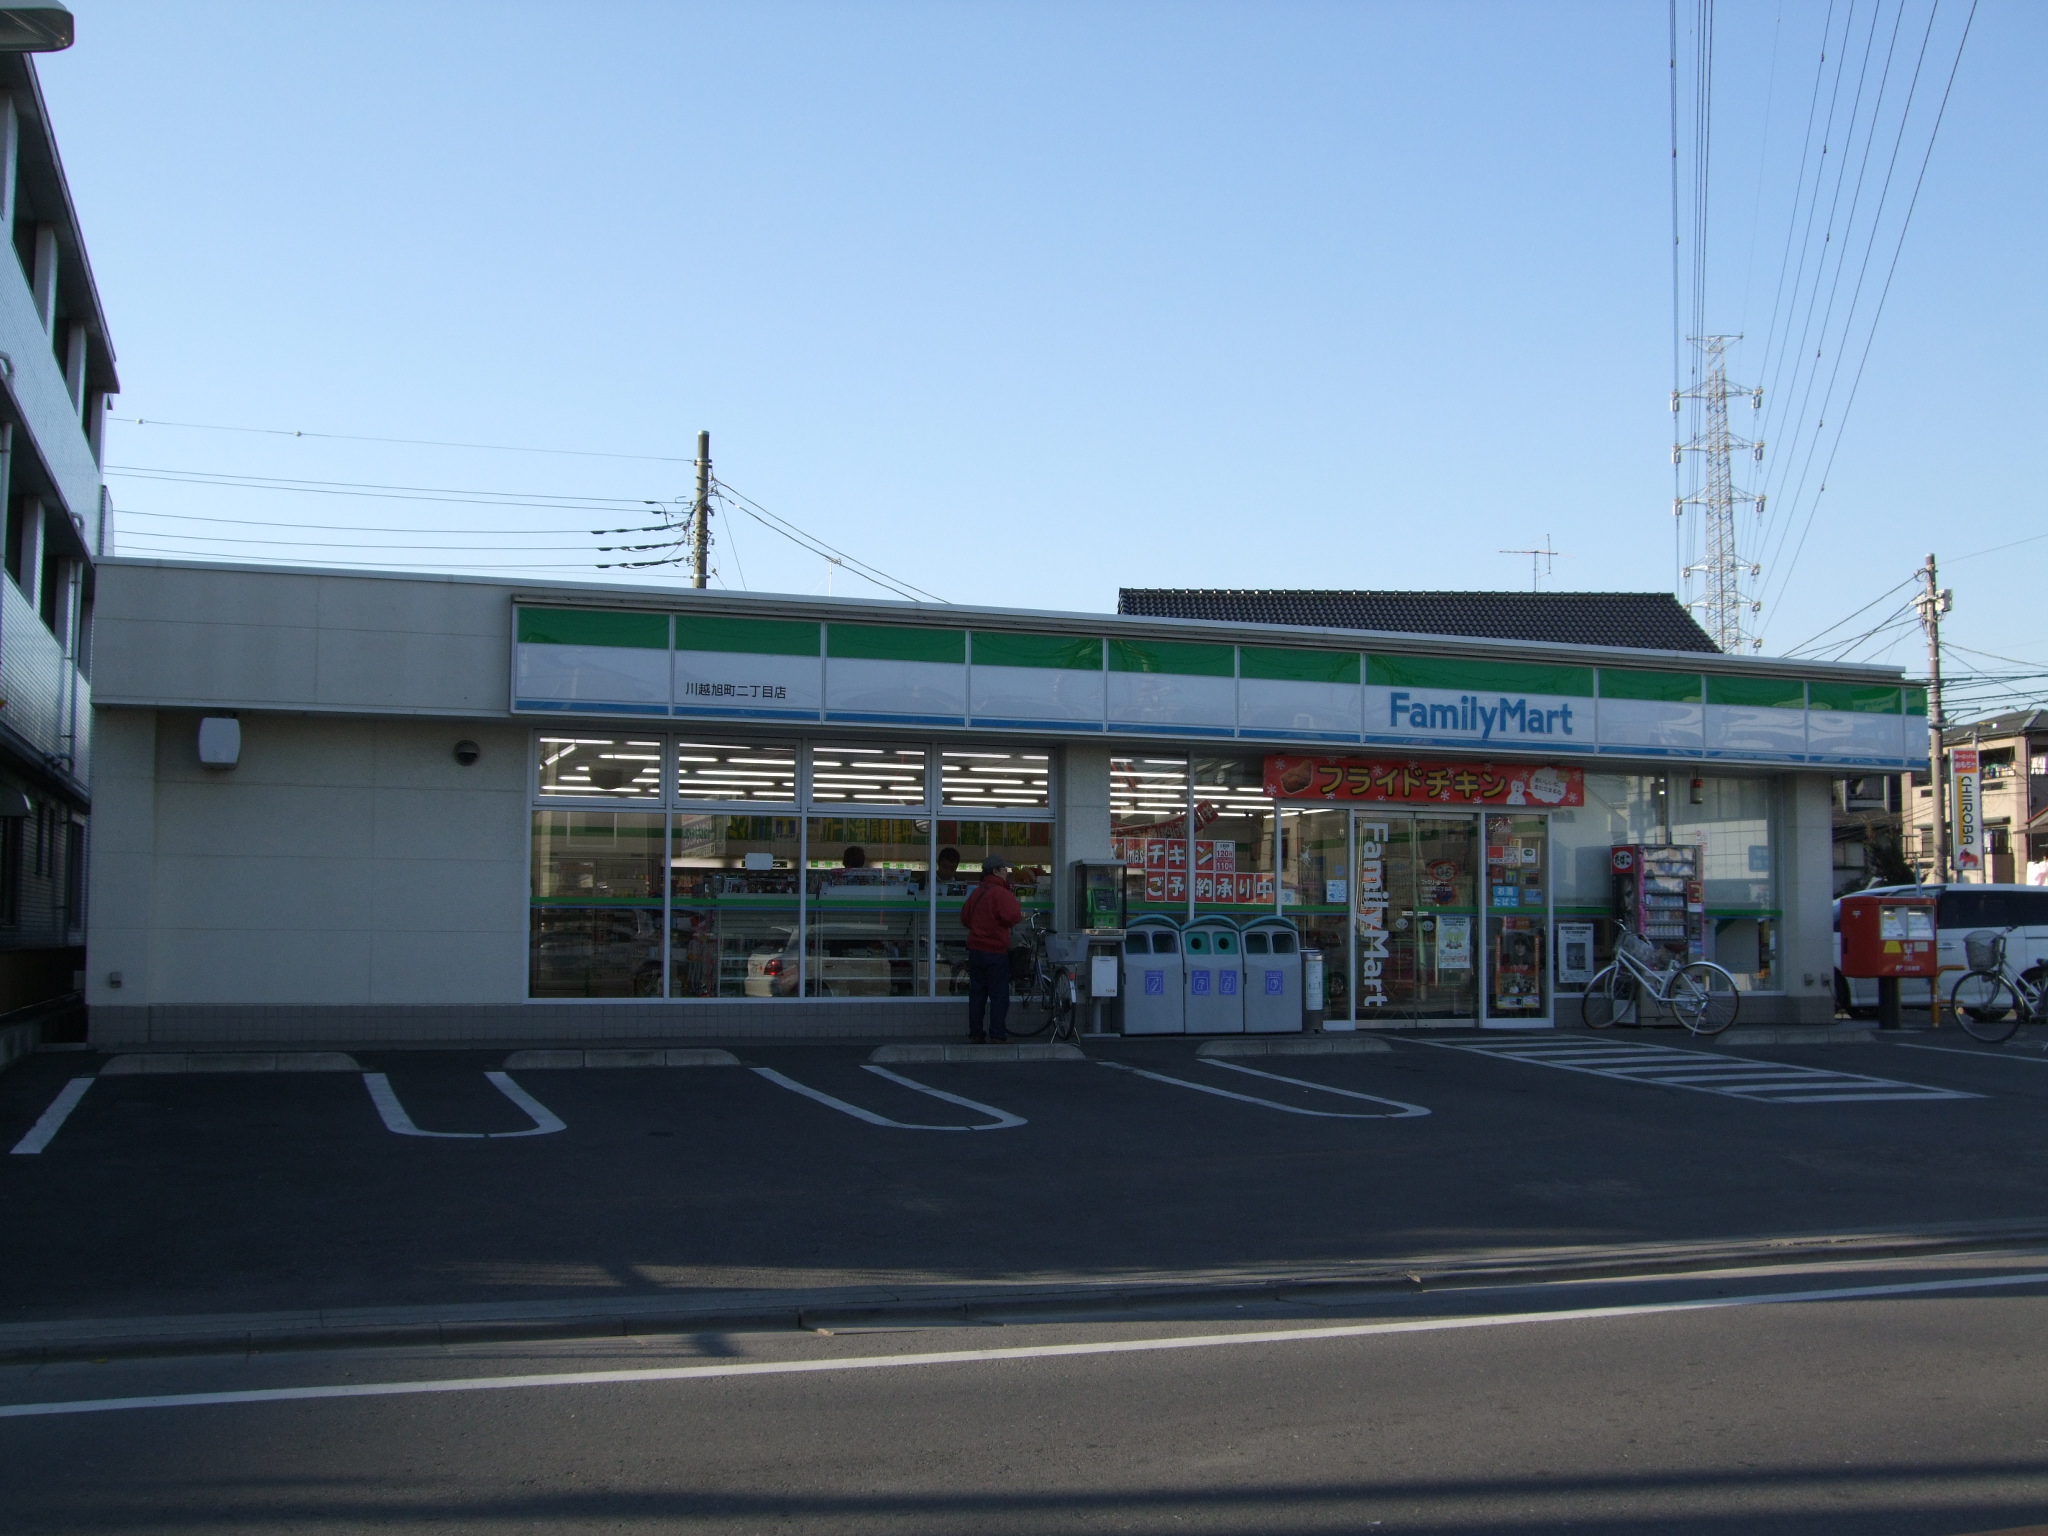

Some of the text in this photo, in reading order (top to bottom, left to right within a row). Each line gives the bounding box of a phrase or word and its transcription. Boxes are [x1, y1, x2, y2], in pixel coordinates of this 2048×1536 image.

[685, 682, 787, 699] 川越旭町二丁目店
[1390, 692, 1573, 739] FamilyMart
[1318, 766, 1506, 799] フライドチキン
[1961, 776, 1974, 845] CHIIROBA
[1148, 876, 1273, 899] ご予約承り中
[1357, 823, 1390, 1007] FamilyMart
